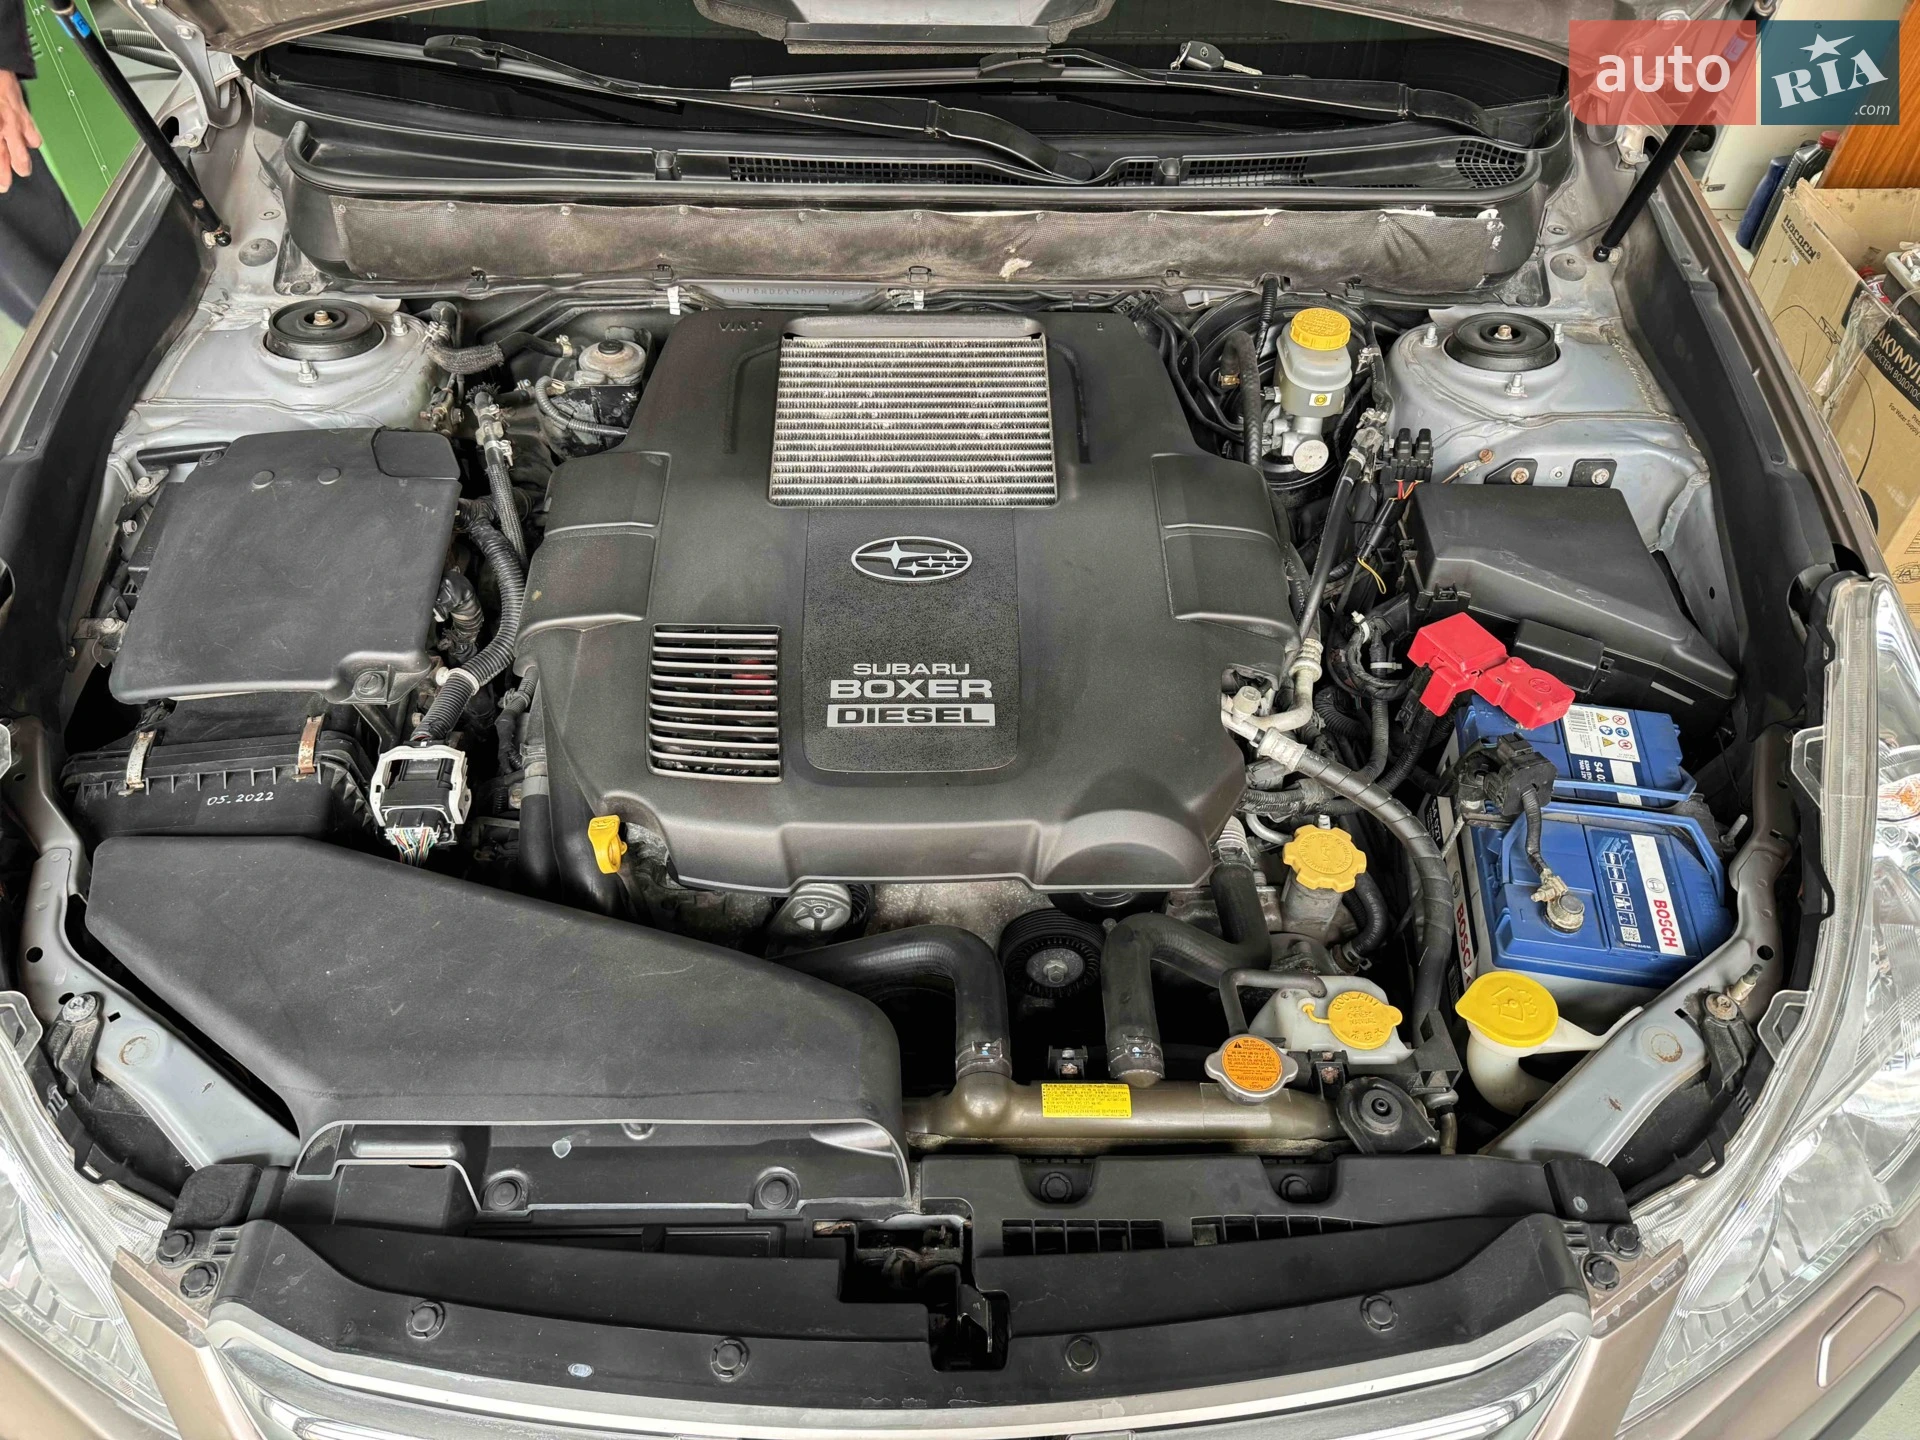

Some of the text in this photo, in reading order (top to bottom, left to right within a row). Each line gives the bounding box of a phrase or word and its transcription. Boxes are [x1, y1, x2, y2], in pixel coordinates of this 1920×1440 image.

[1875, 328, 1920, 387] АКУМУЛ
[1892, 369, 1920, 403] ВОДОПОС
[853, 663, 970, 675] SUBARU
[830, 679, 993, 699] BOXER
[837, 707, 990, 724] DIESEL
[1653, 899, 1678, 948] BOSCH
[1456, 901, 1473, 983] BOSC
